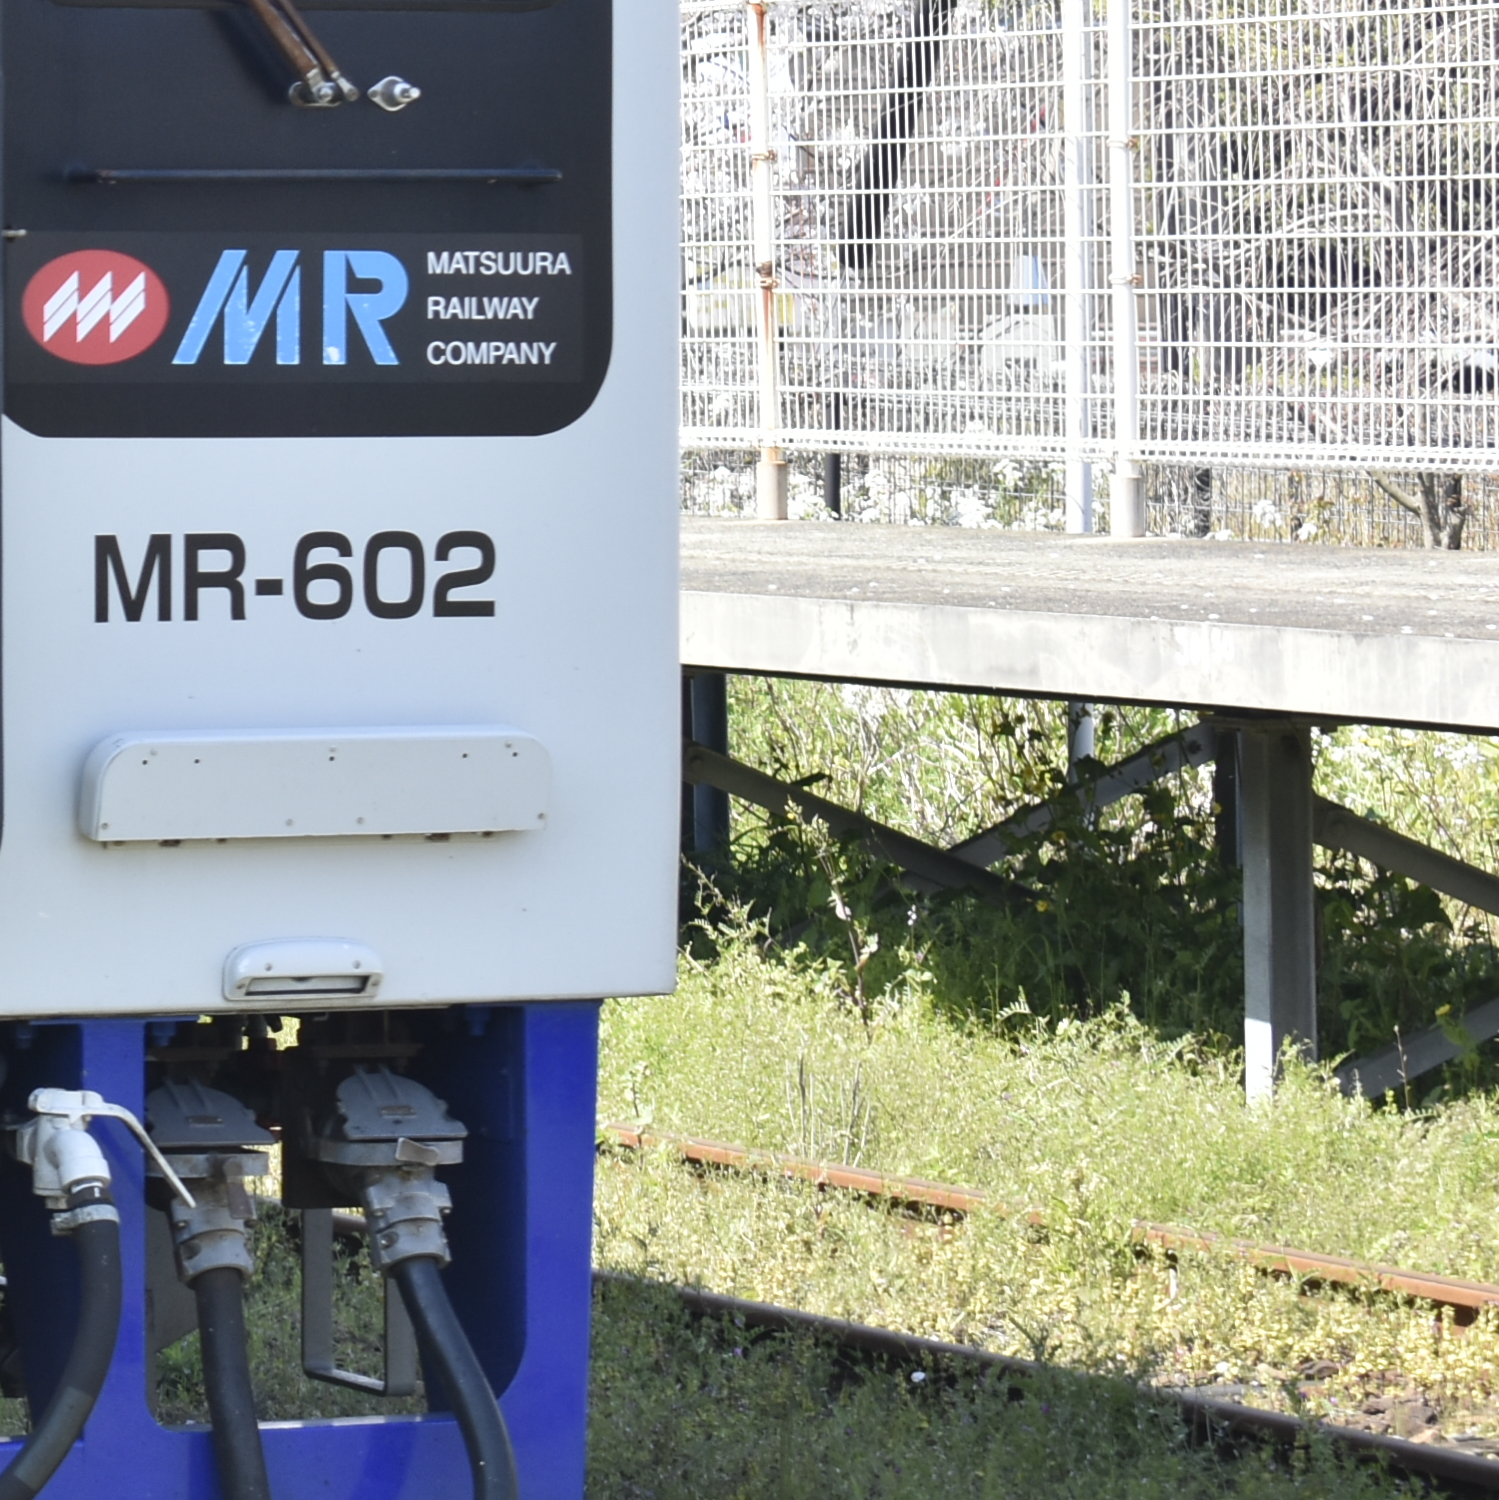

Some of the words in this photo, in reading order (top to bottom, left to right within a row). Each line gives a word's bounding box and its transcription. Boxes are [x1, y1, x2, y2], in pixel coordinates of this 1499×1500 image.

[426, 250, 572, 277] MATSUURA
[171, 249, 410, 365] MR
[426, 296, 540, 321] RAILWAY
[425, 340, 557, 366] COMPANY
[93, 529, 497, 624] MR-602
